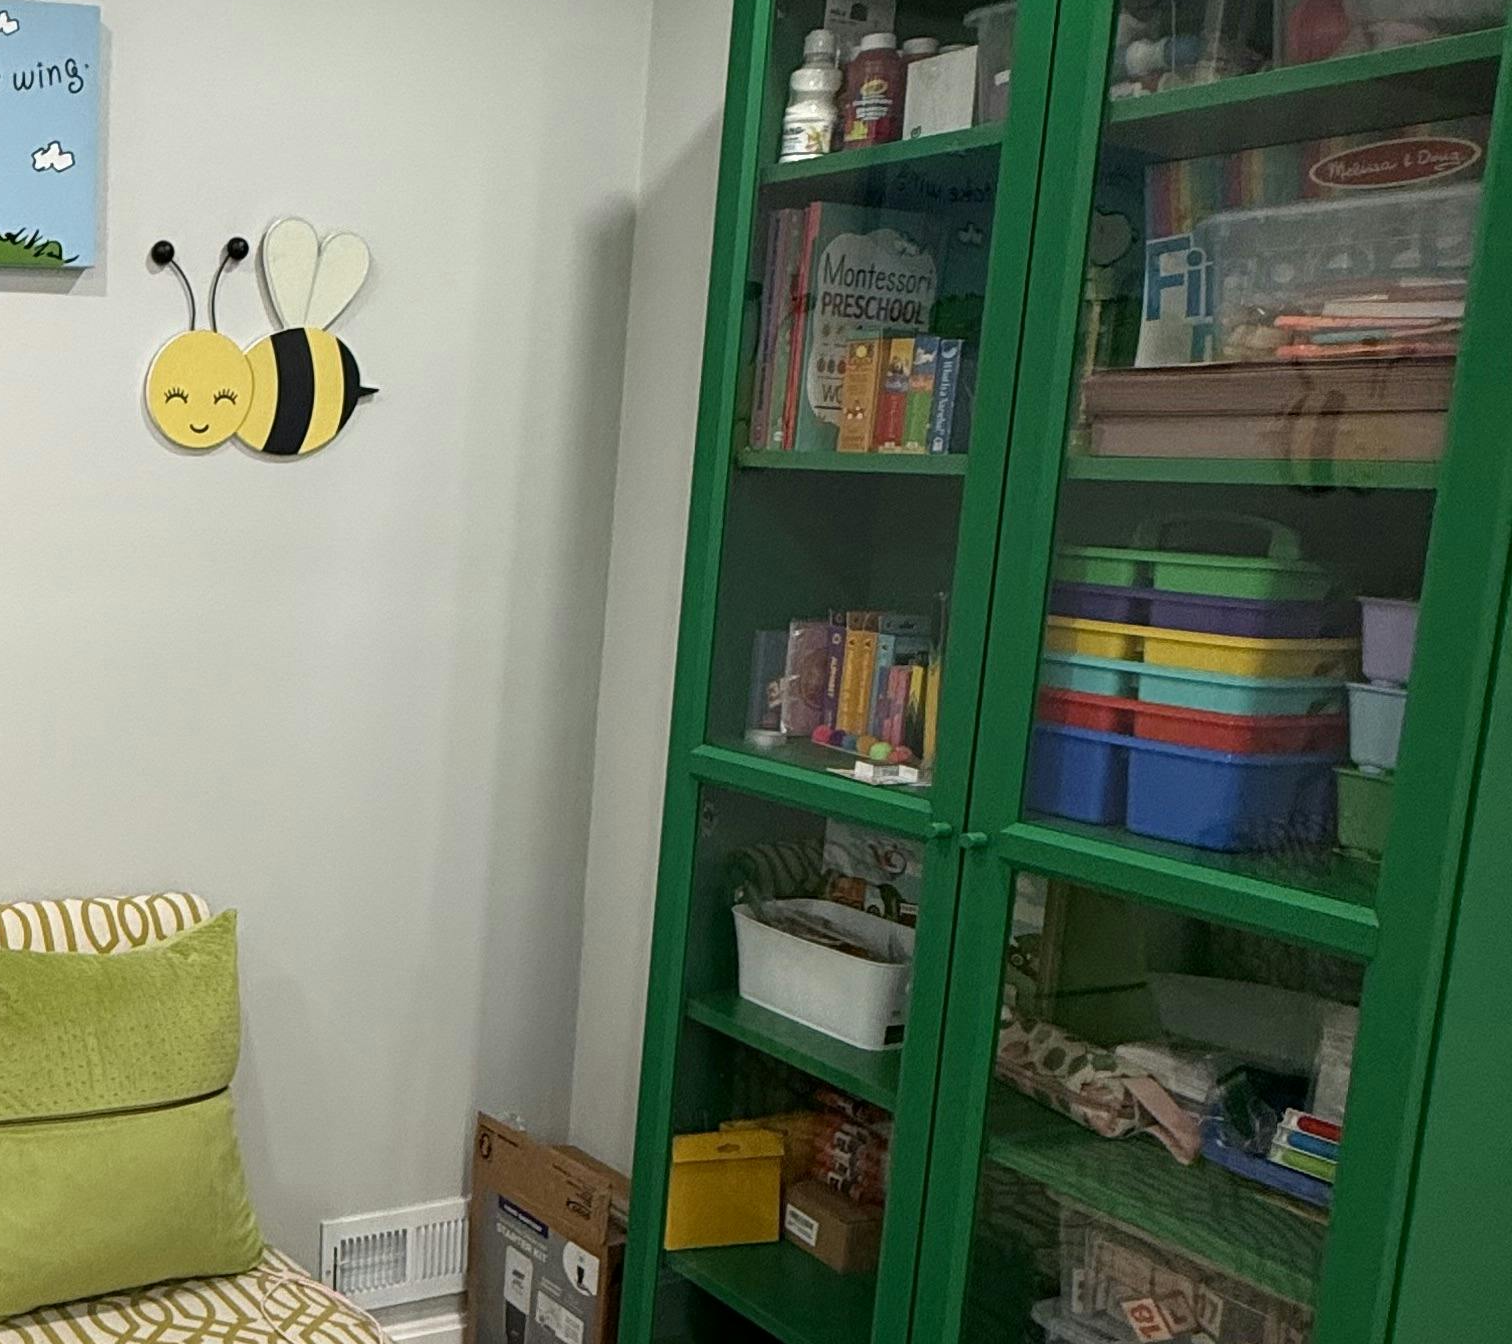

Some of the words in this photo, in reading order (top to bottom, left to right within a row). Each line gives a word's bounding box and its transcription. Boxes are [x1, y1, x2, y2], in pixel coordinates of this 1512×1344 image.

[1328, 159, 1397, 179] Melissa
[823, 253, 934, 293] Montessori
[820, 291, 925, 325] PRESCHOOL
